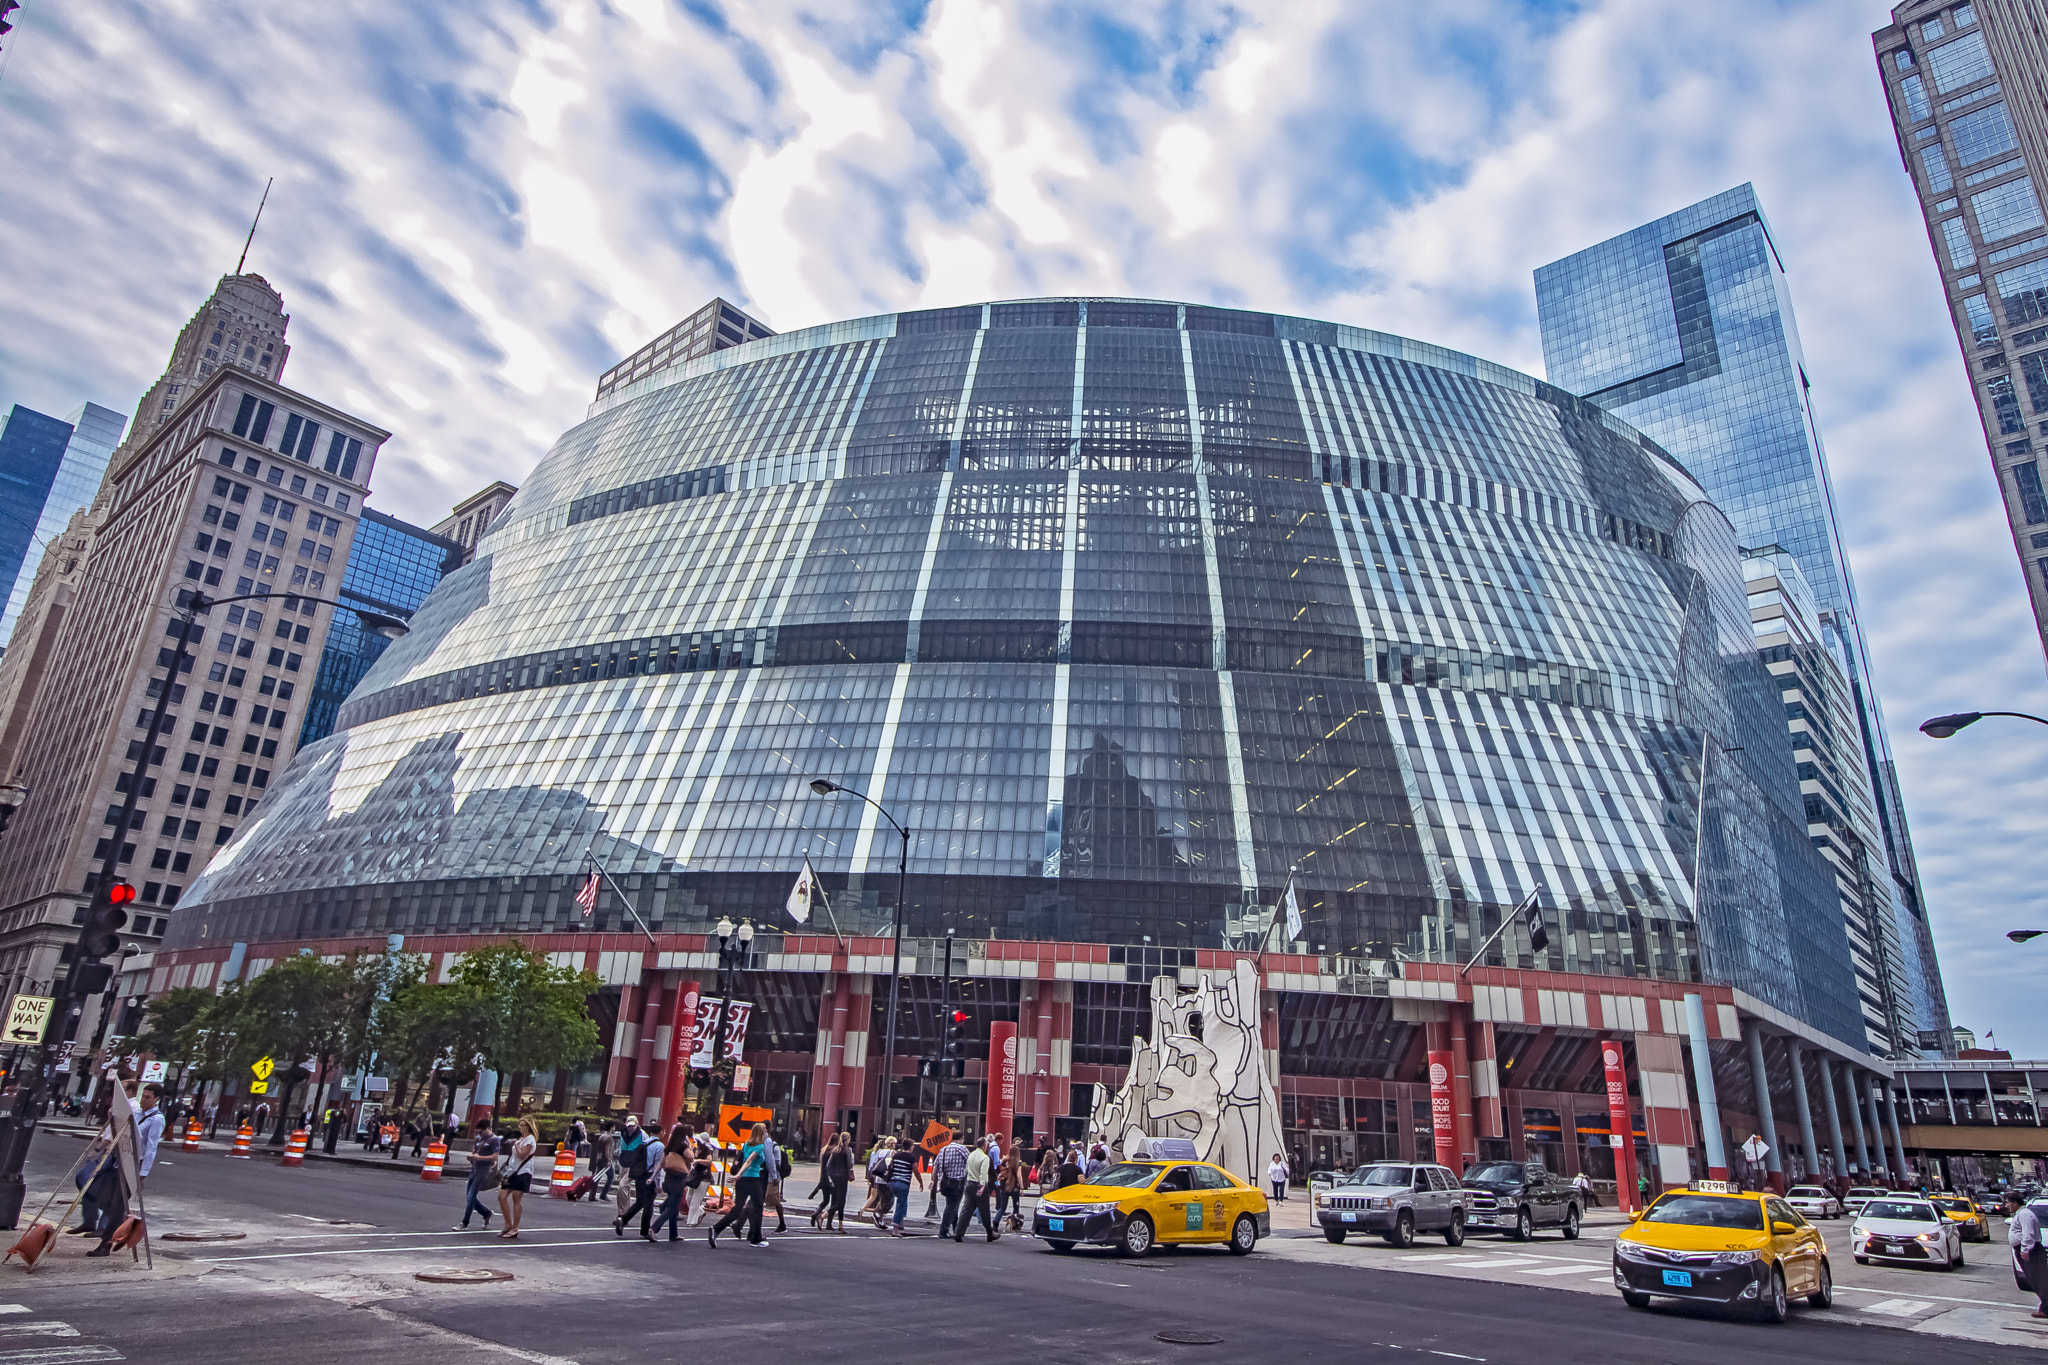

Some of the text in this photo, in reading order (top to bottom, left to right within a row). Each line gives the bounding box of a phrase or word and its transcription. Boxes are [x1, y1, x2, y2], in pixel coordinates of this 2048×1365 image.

[17, 1000, 47, 1012] ONE
[698, 1002, 722, 1020] ST
[728, 1005, 751, 1022] ST
[13, 1012, 43, 1025] WAY
[926, 1131, 950, 1148] BUMP
[1700, 1182, 1726, 1191] 4298
